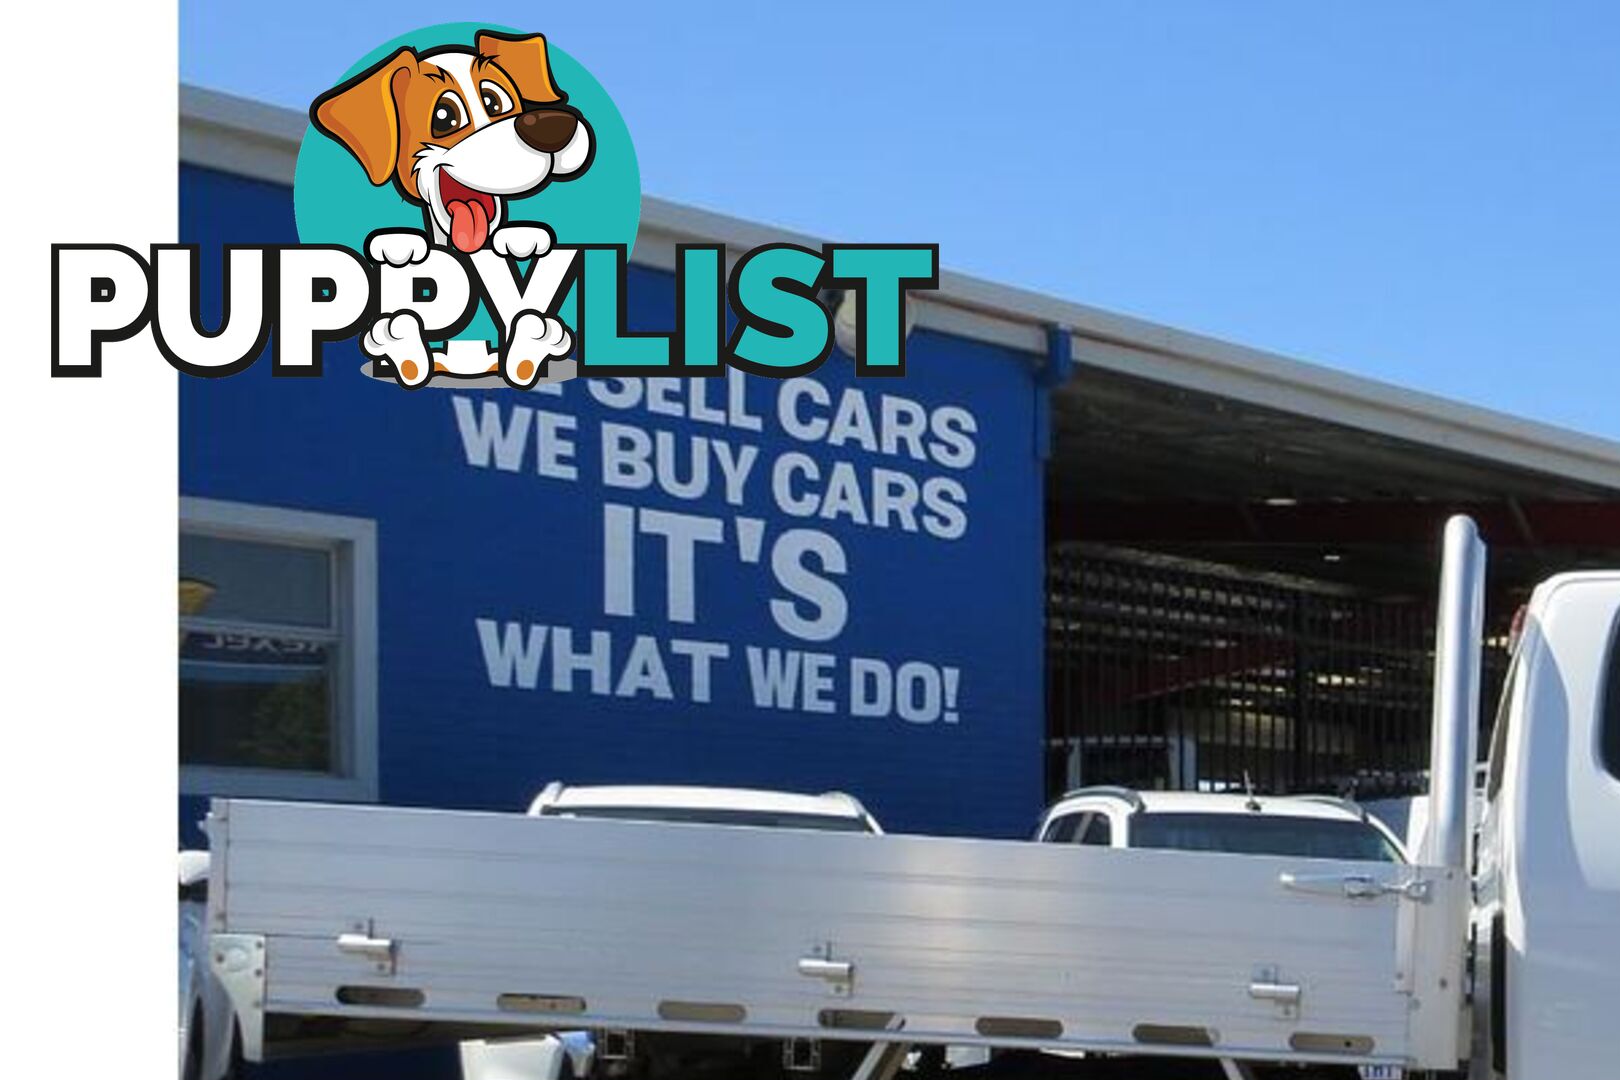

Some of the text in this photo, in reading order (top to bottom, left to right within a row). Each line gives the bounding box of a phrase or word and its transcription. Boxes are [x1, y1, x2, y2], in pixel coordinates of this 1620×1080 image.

[453, 397, 967, 539] WE BUY CARS
[777, 377, 977, 469] CARS
[603, 503, 848, 641] IT'S
[475, 618, 960, 724] WHAT WE DO!
